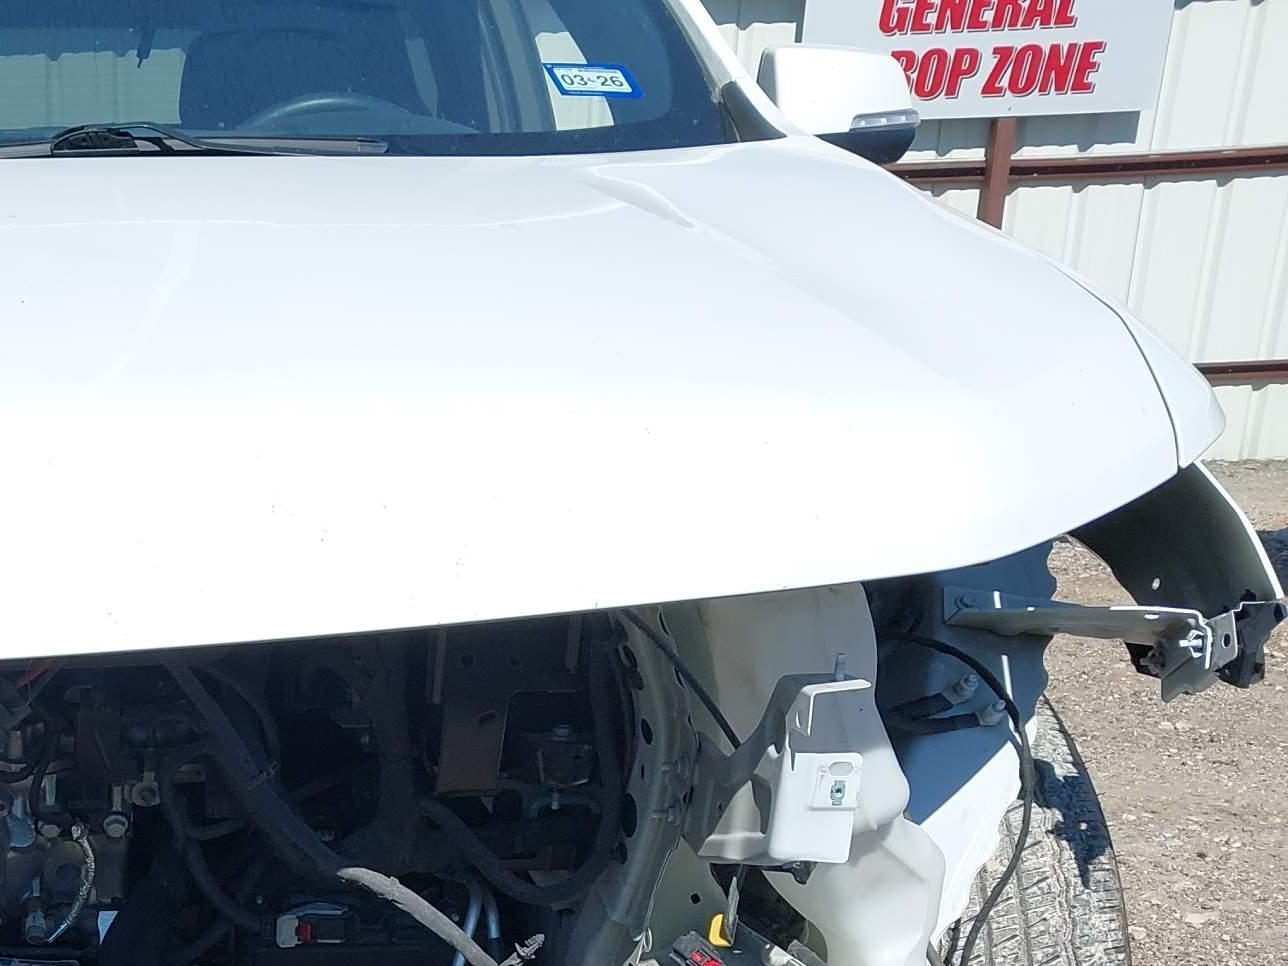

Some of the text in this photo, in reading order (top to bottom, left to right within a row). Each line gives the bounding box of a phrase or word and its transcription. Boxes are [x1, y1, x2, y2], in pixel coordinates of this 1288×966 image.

[878, 0, 1079, 36] GENERAL
[890, 40, 1106, 100] ROP ZONE
